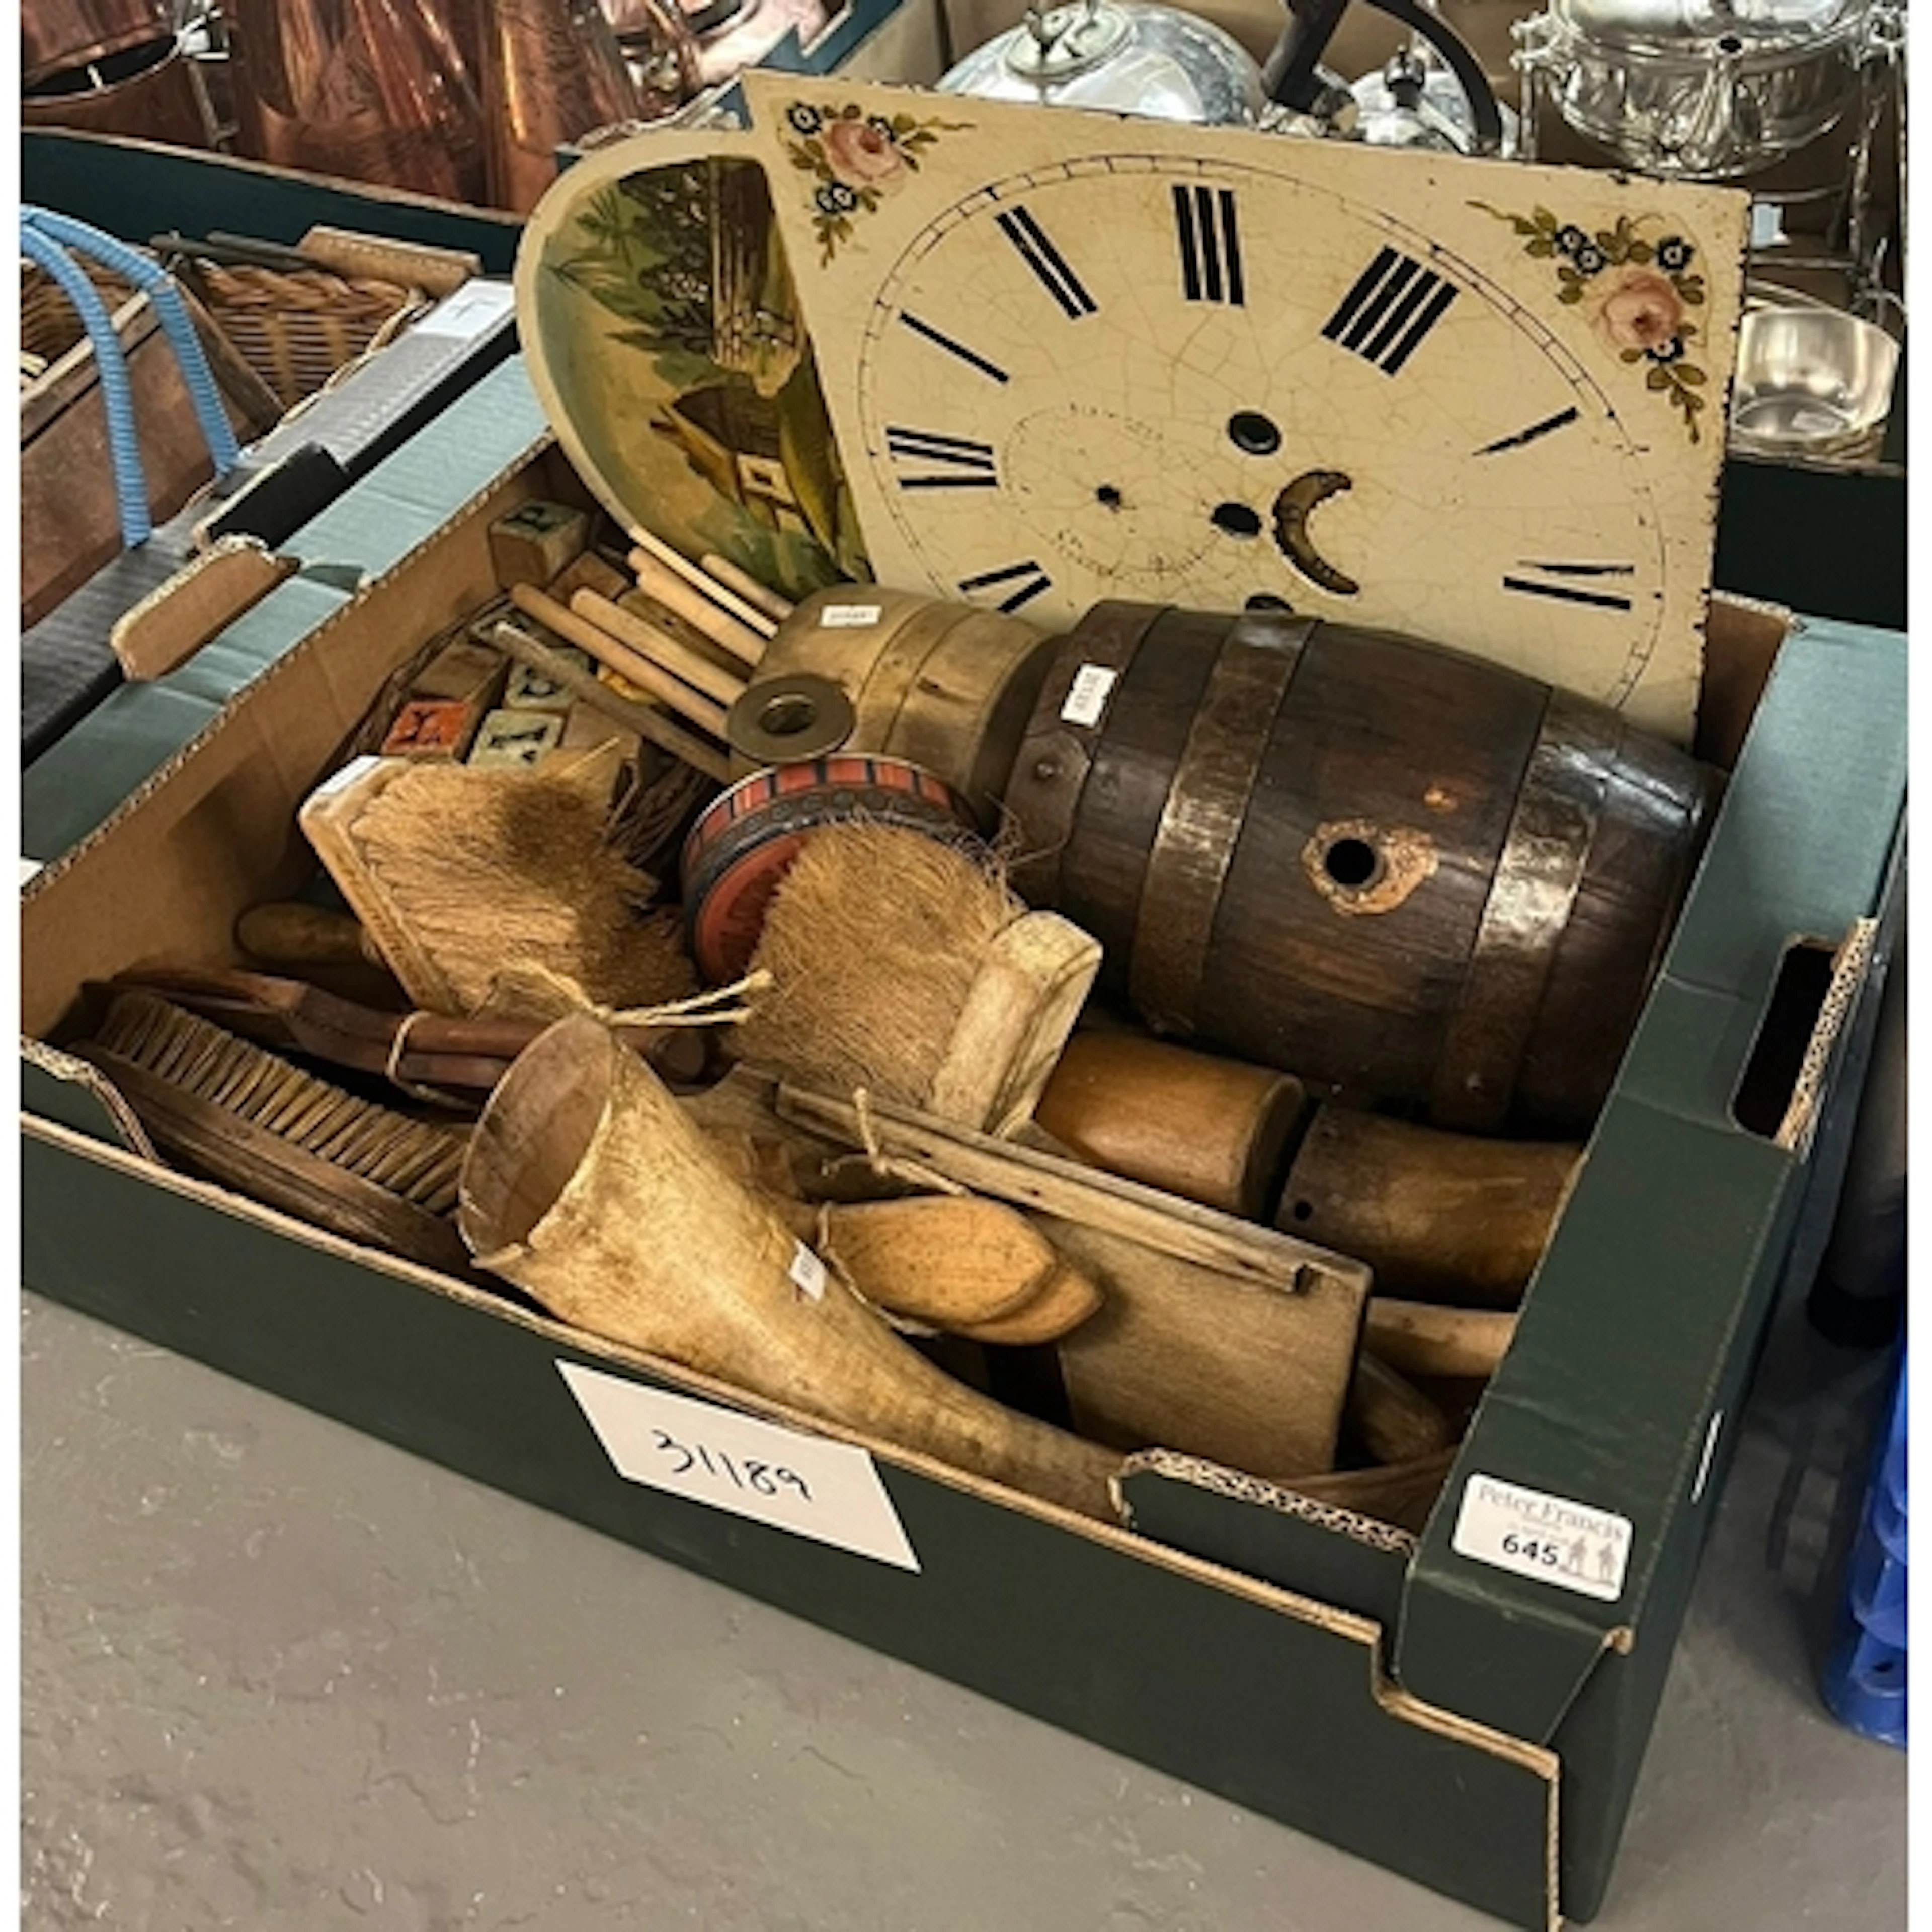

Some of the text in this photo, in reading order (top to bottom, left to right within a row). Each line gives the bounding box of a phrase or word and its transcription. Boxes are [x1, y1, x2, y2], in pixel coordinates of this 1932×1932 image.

[651, 1428, 812, 1503] 31189
[1479, 1483, 1539, 1514] Peter
[1541, 1501, 1624, 1540] Francis
[1501, 1533, 1558, 1566] 645
